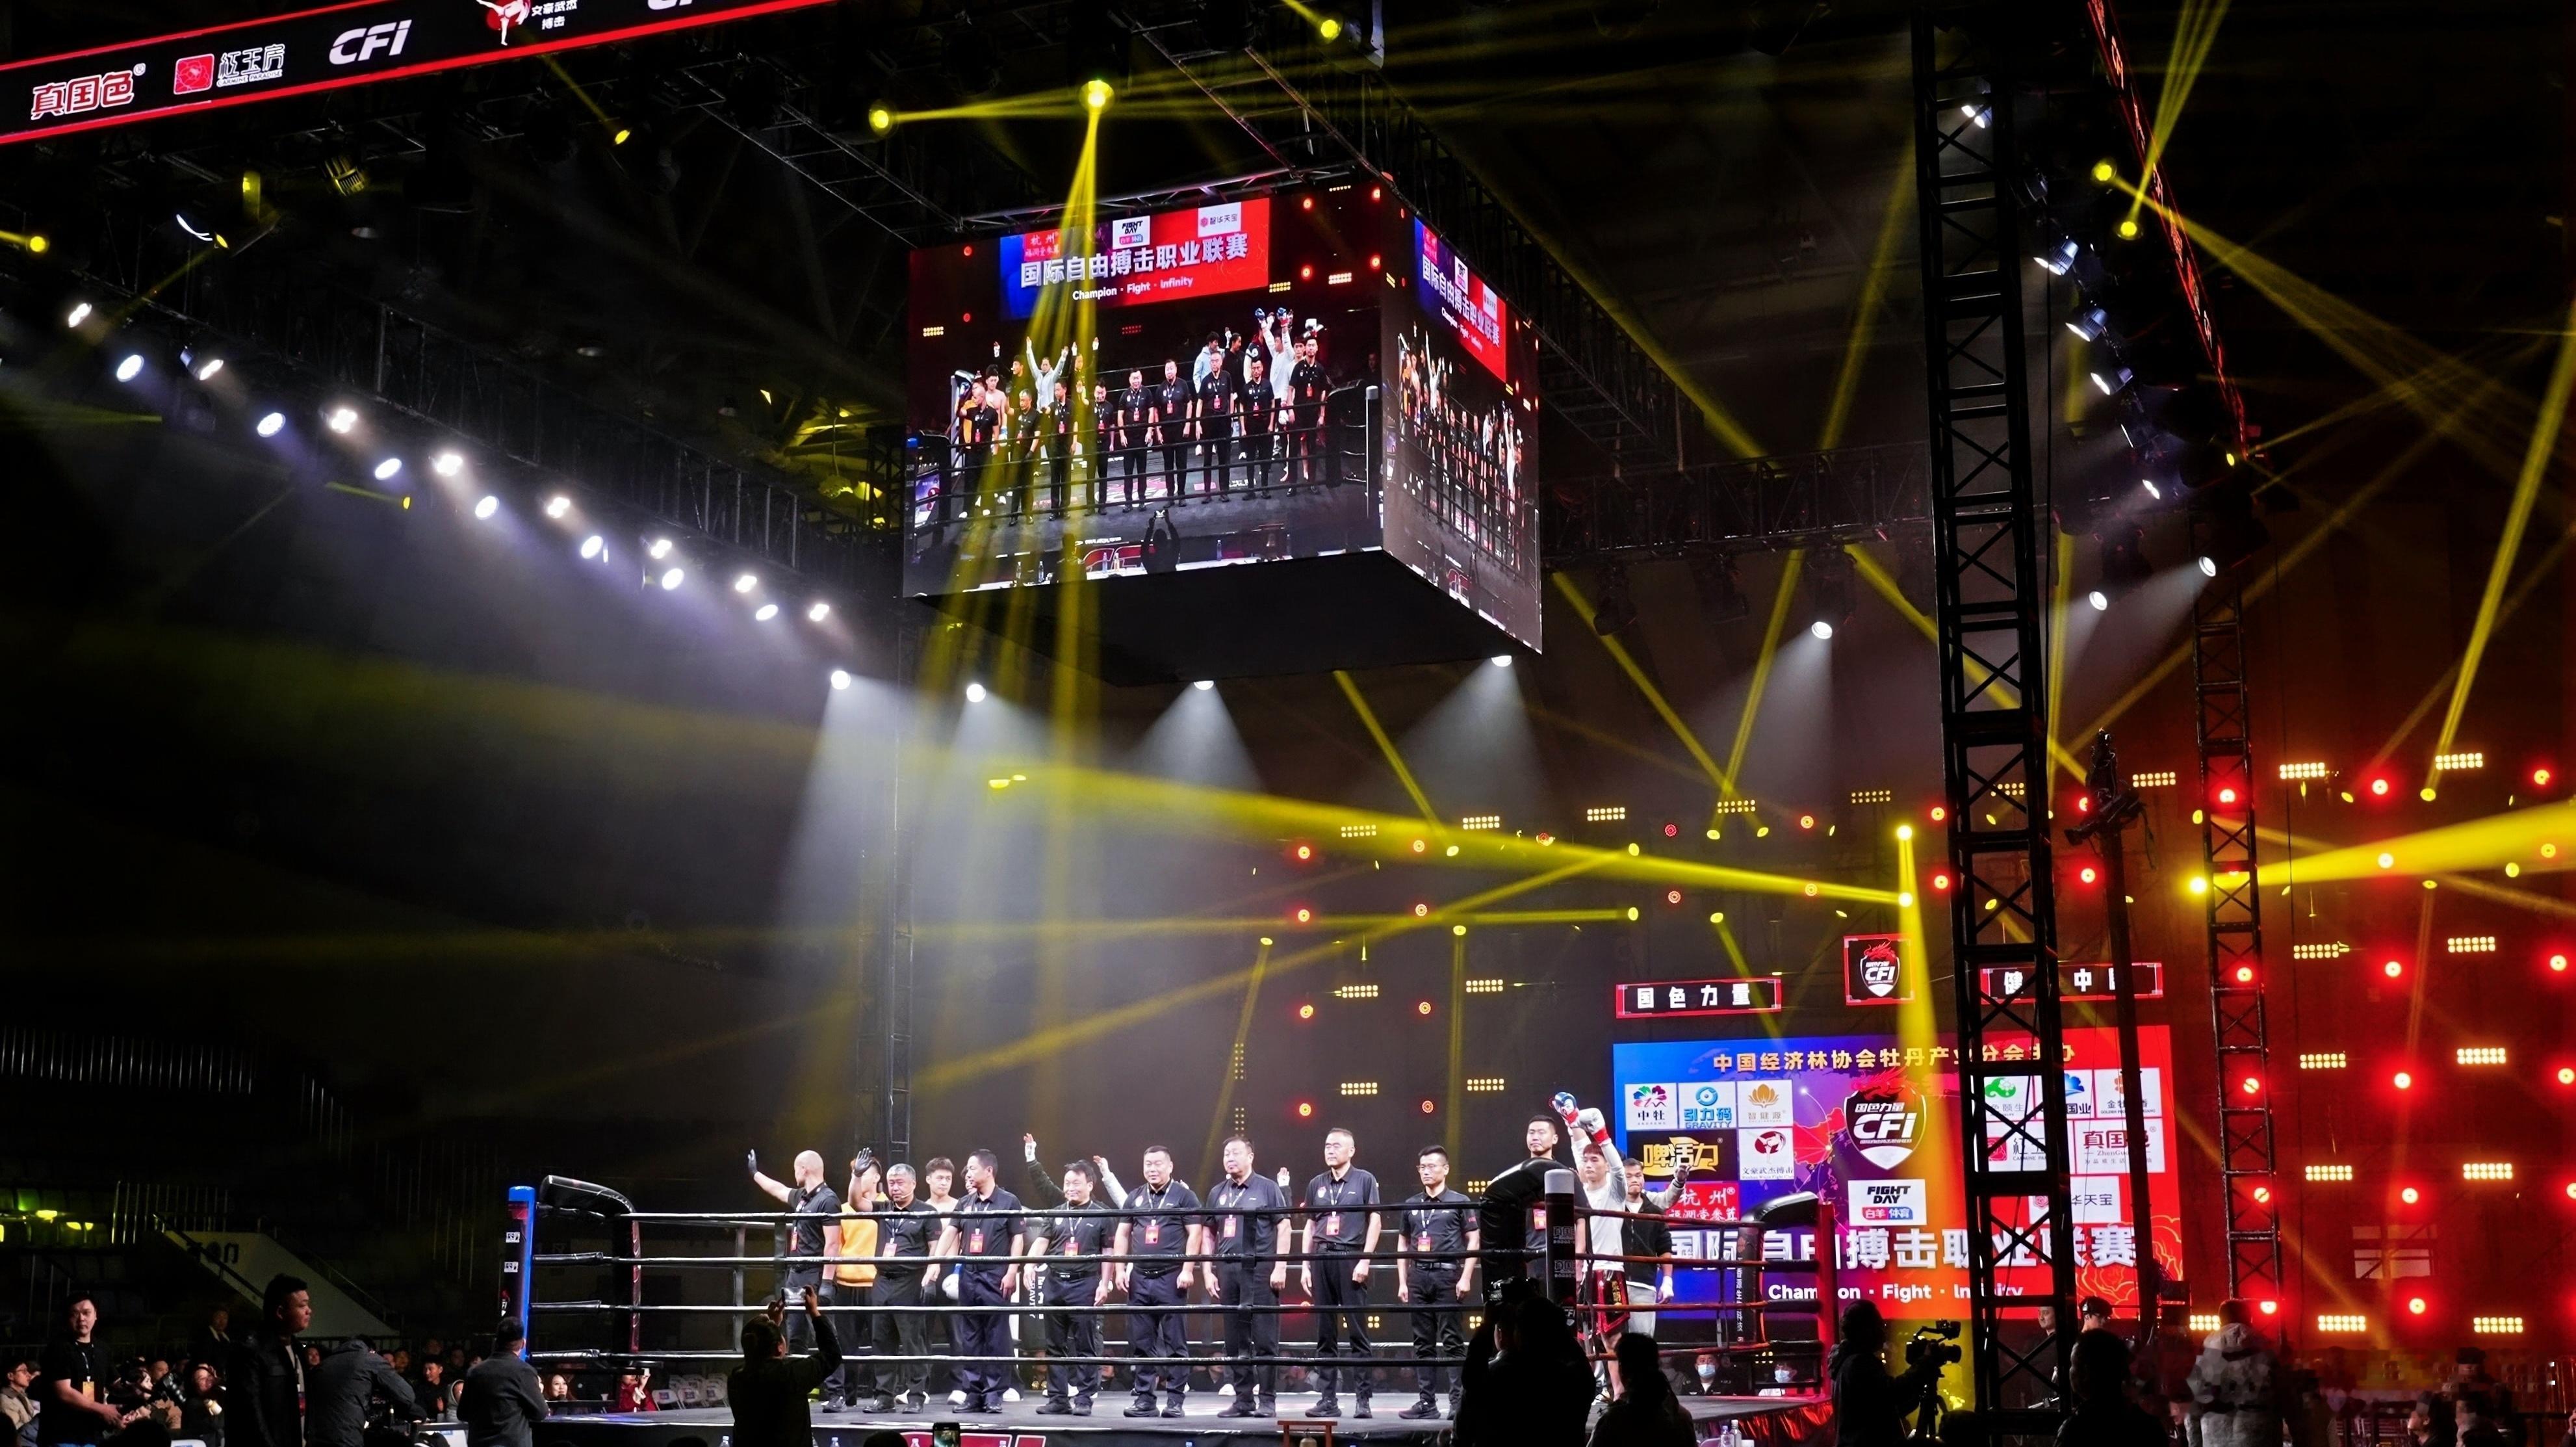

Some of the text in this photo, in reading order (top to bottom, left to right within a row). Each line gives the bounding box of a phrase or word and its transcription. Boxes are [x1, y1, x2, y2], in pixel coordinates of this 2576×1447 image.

[541, 16, 565, 30] 搏击
[329, 19, 412, 65] CFI
[31, 70, 135, 120] 真国色
[1021, 233, 1248, 288] 国际自由搏击职业联赛
[1072, 276, 1194, 301] Champion Fight Infinity
[1423, 254, 1500, 348] 国际自由搏击职业联赛
[1865, 966, 1896, 981] CFI
[1637, 983, 1751, 1009] 国色力量
[1638, 1110, 1665, 1121] 中牡
[1684, 1107, 1732, 1122] 引力码
[1685, 1121, 1732, 1129] GRAVITY
[1853, 1112, 1917, 1139] CFI
[1678, 1188, 1727, 1207] 杭州
[1867, 1186, 1911, 1195] FIGHT
[1874, 1195, 1901, 1204] DAY
[2071, 1193, 2113, 1206] 华天宝
[1768, 1284, 1861, 1300] Chamon
[1883, 1283, 1932, 1303] Fight
